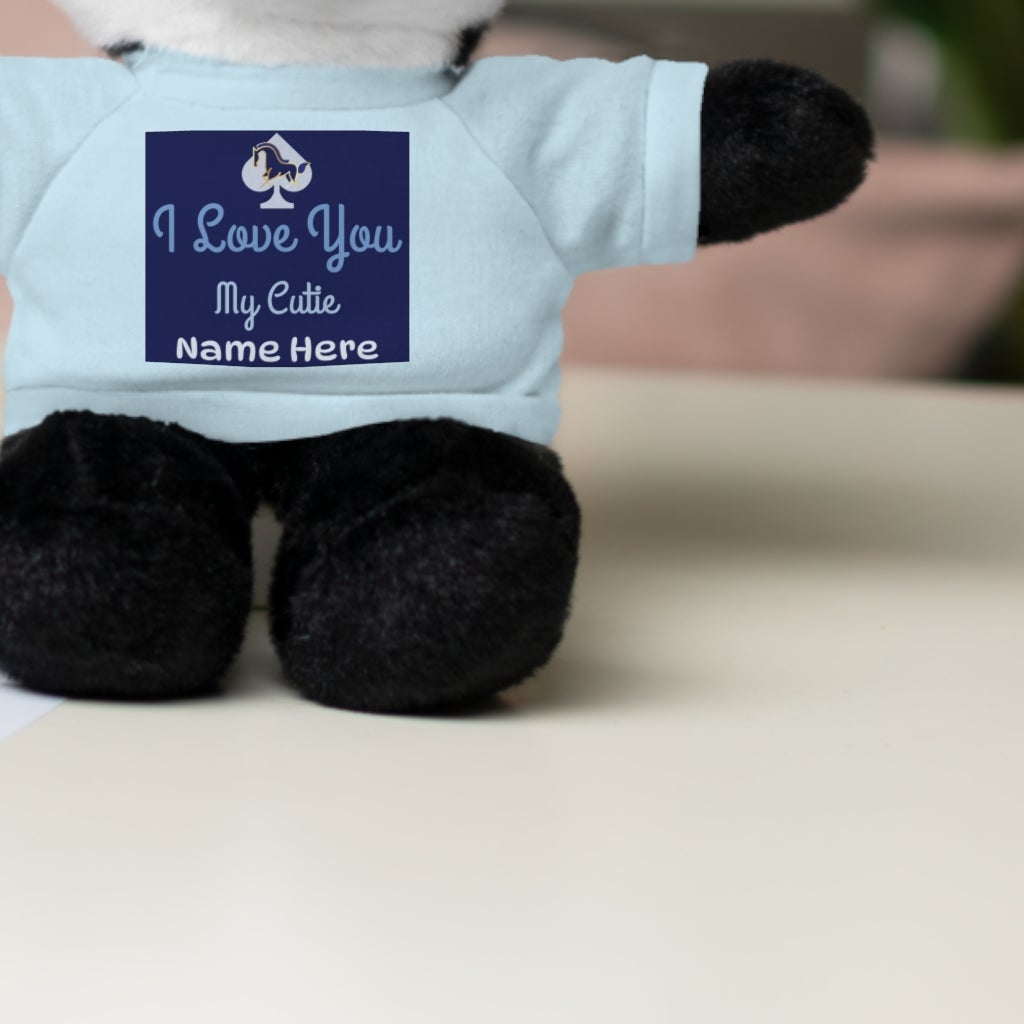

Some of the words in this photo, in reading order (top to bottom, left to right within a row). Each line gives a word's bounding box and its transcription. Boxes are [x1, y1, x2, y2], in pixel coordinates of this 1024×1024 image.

[152, 203, 175, 253] I
[192, 202, 299, 253] Love
[307, 203, 403, 273] You
[214, 280, 262, 331] My
[267, 280, 342, 315] Cutie
[176, 335, 281, 363] Name
[290, 335, 380, 363] Here
